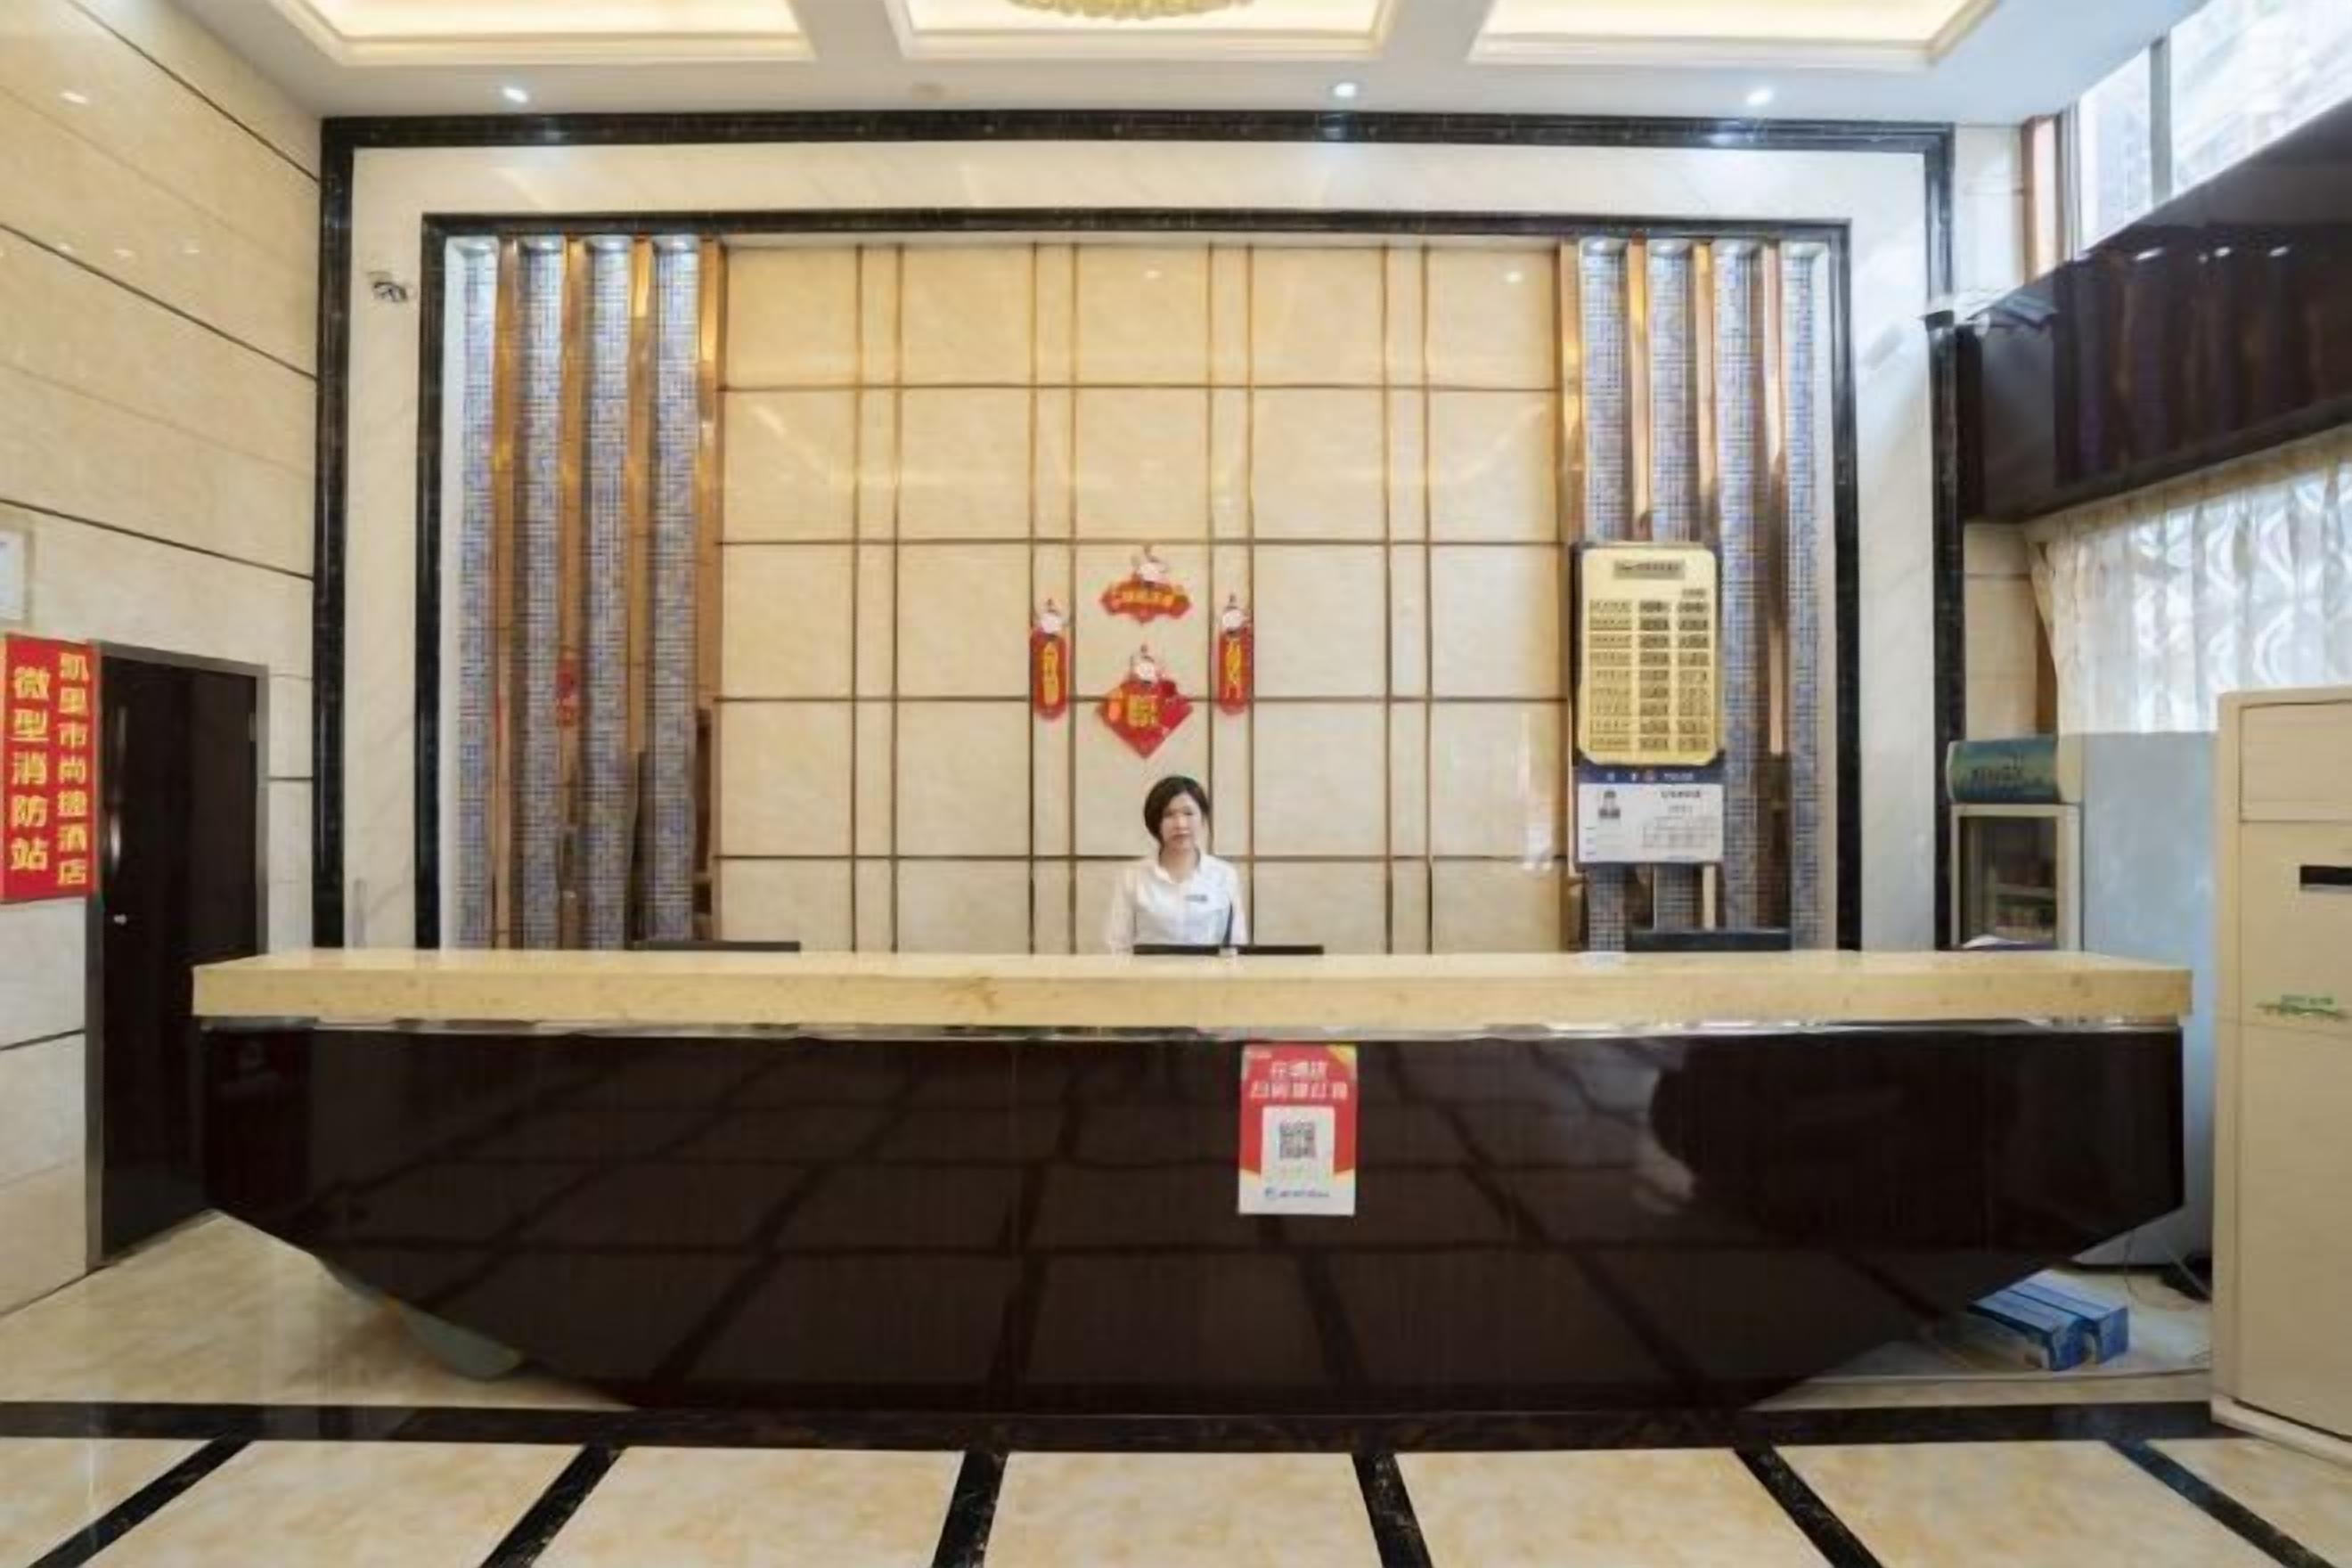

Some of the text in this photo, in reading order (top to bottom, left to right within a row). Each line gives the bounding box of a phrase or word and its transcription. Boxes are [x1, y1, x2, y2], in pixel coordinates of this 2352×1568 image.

[11, 666, 49, 870] 微型消防站
